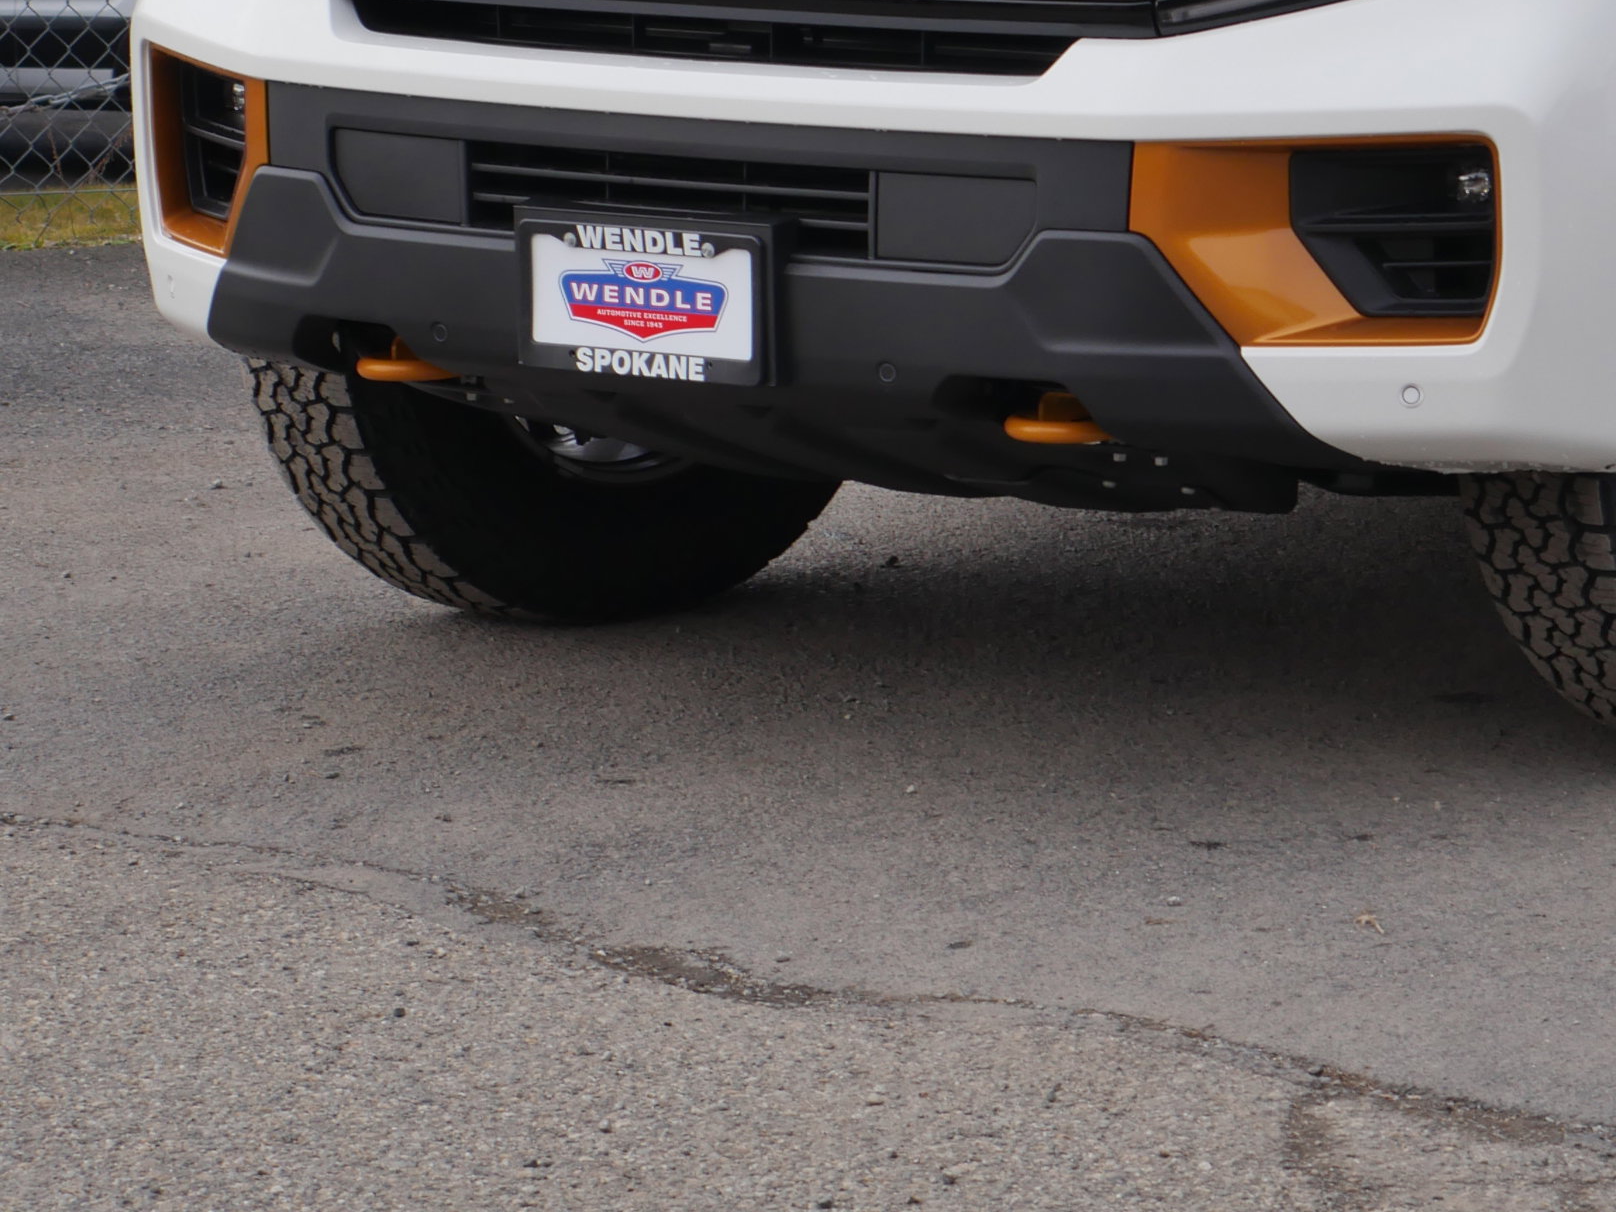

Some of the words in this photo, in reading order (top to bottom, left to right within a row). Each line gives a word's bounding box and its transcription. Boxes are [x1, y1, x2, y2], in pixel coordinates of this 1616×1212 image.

[576, 224, 702, 257] WENDLE
[631, 265, 655, 279] W
[570, 282, 713, 311] WENDLE
[597, 308, 642, 319] AUTOMOTIVE
[643, 312, 688, 323] EXCELLENCE
[624, 319, 645, 328] SINCE
[576, 346, 705, 382] SPOKANE
